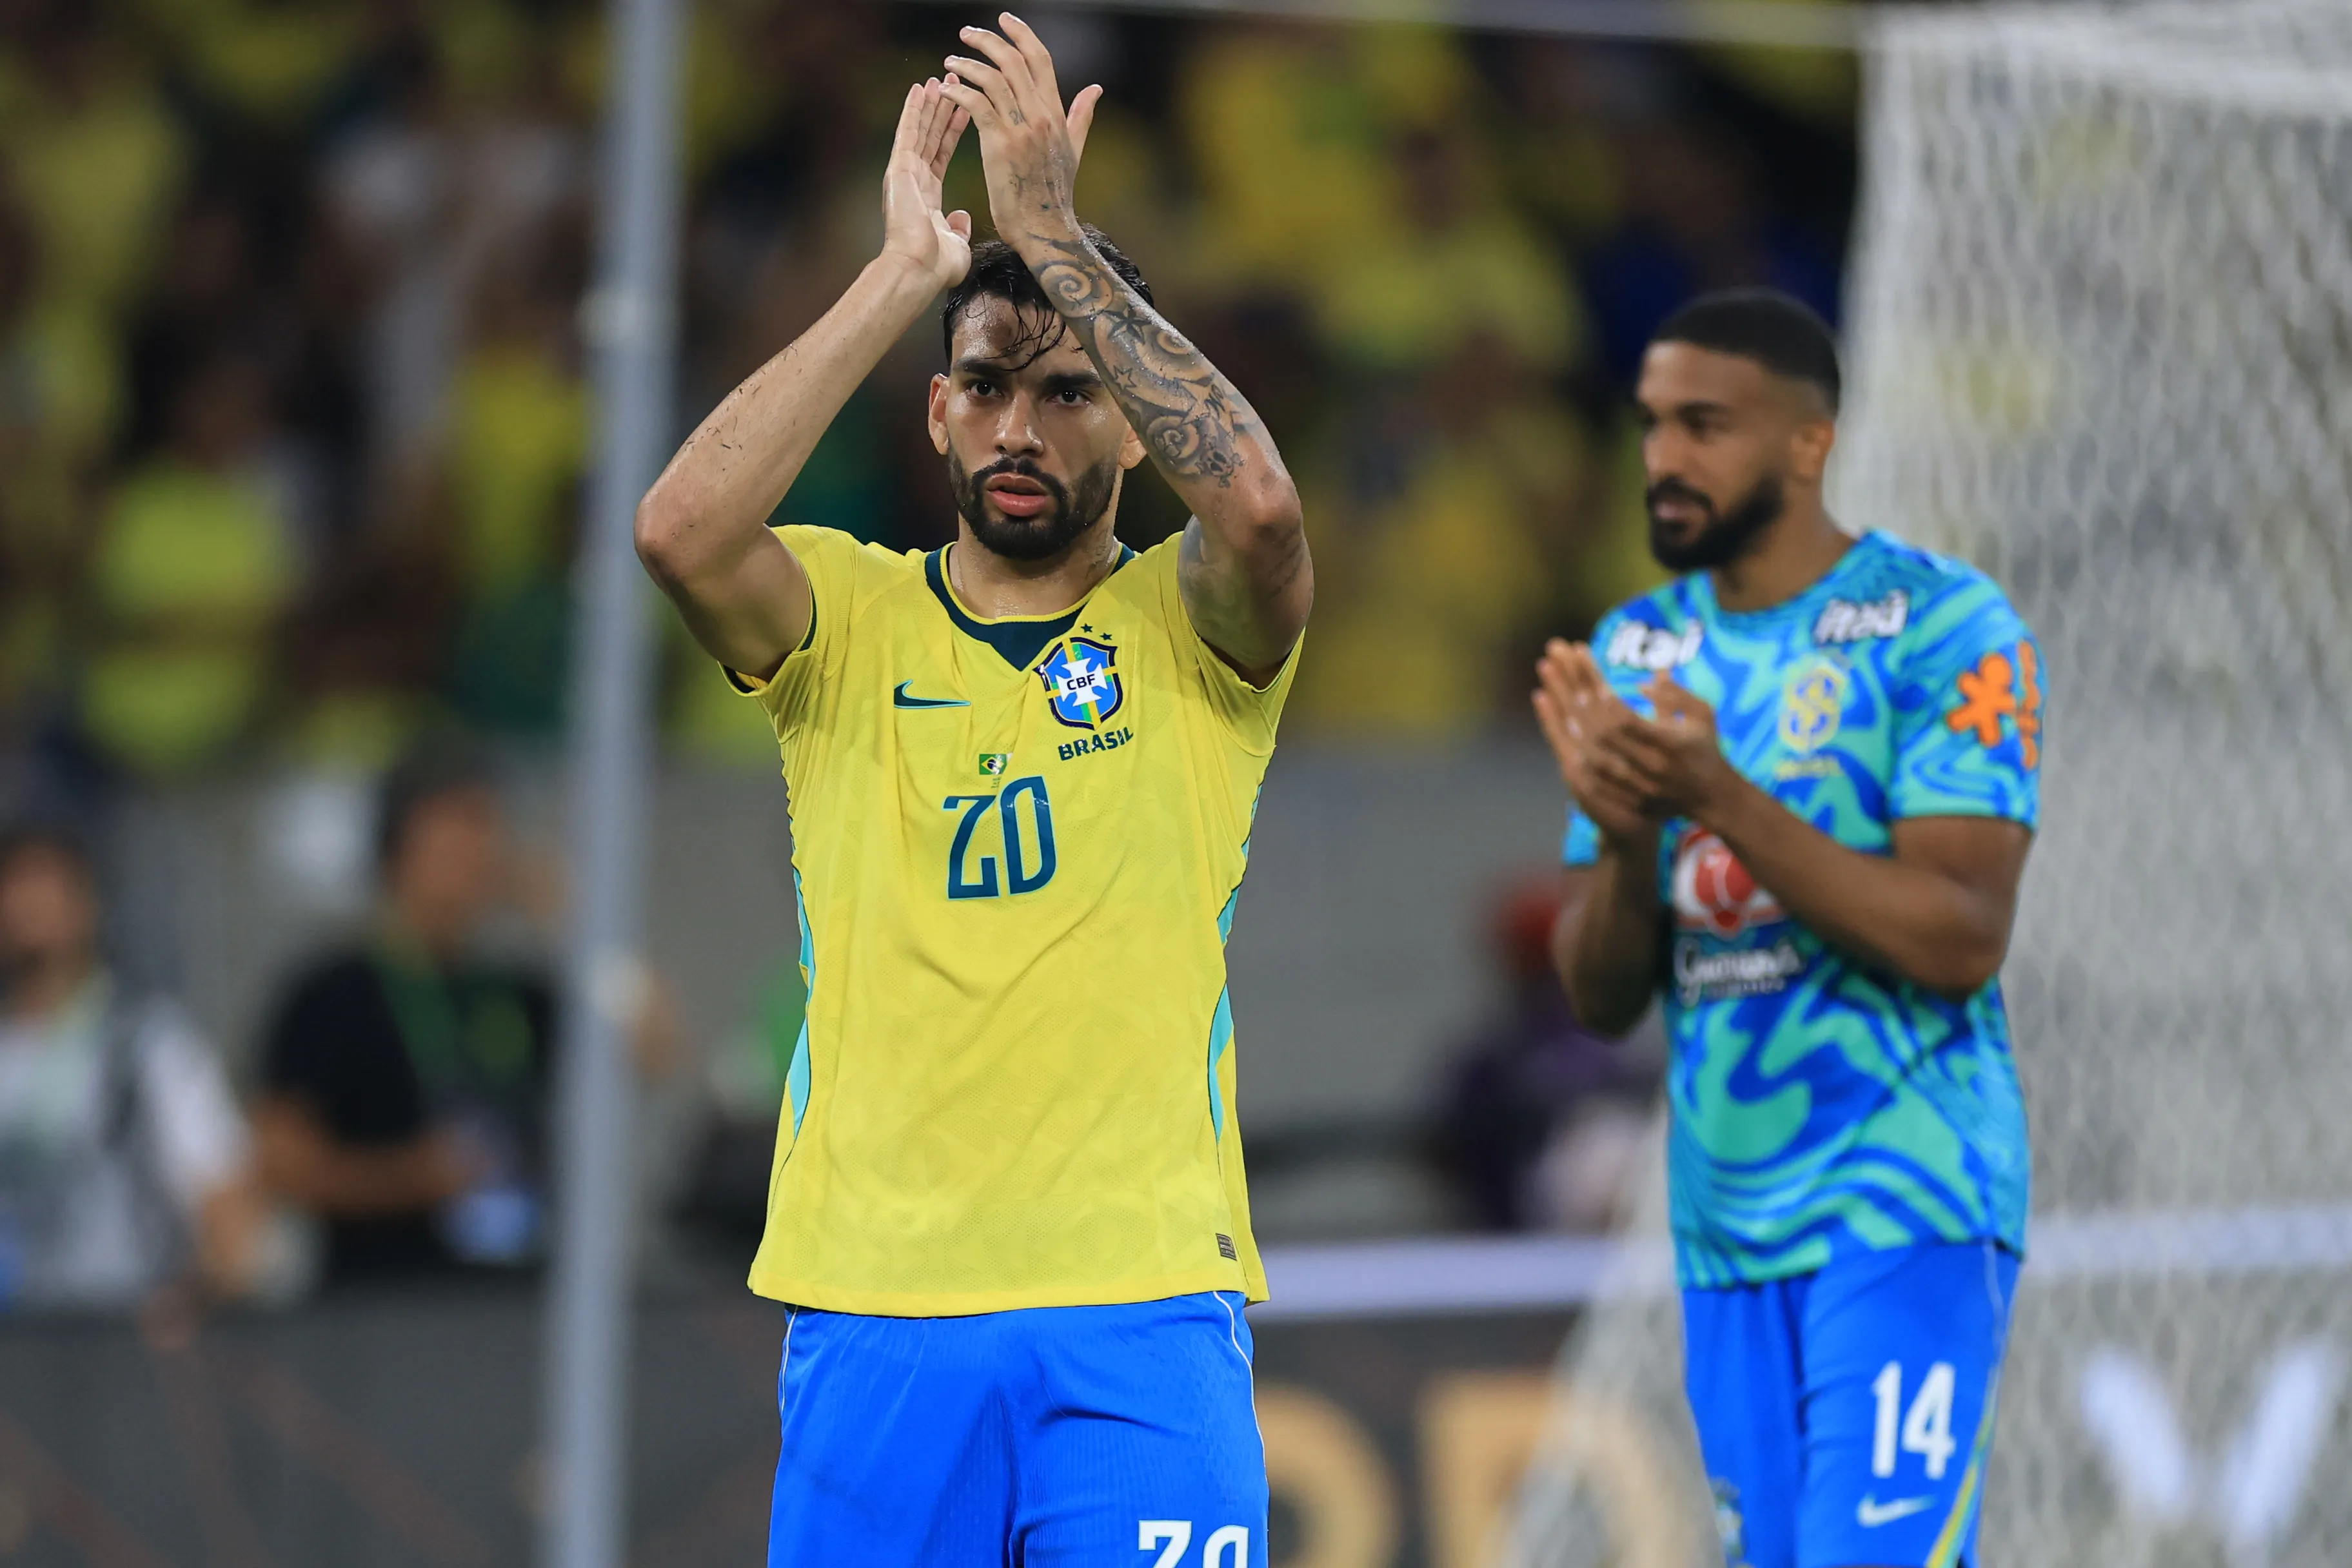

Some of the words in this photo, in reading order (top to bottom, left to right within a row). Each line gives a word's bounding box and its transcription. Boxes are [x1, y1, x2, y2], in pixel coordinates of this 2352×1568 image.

[1067, 674, 1095, 691] CBF
[1058, 727, 1134, 761] BRASIL
[942, 776, 1058, 900] 20
[1871, 1360, 1956, 1480] 14
